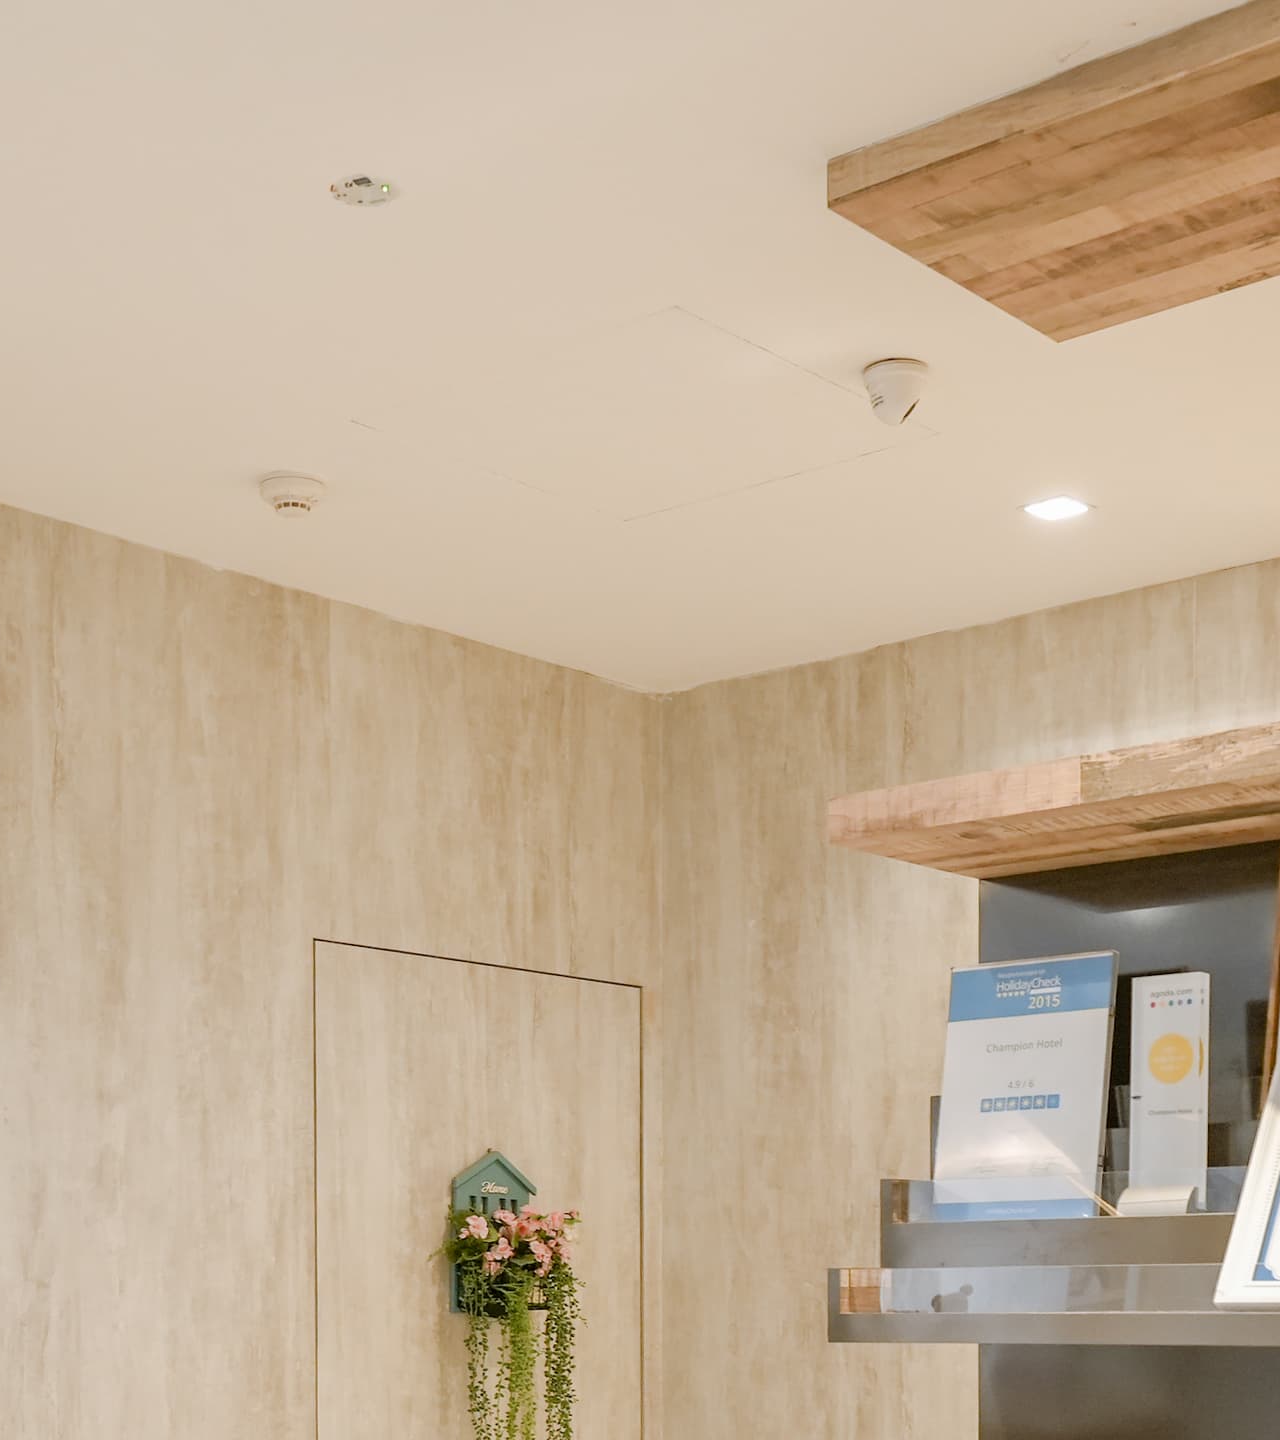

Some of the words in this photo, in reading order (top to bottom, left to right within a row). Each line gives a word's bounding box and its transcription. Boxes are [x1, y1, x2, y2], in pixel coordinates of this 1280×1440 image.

[996, 975, 1061, 992] HolidayCheck
[1028, 995, 1060, 1009] 2015
[986, 1040, 1034, 1054] Champion
[1036, 1038, 1064, 1049] Hotel
